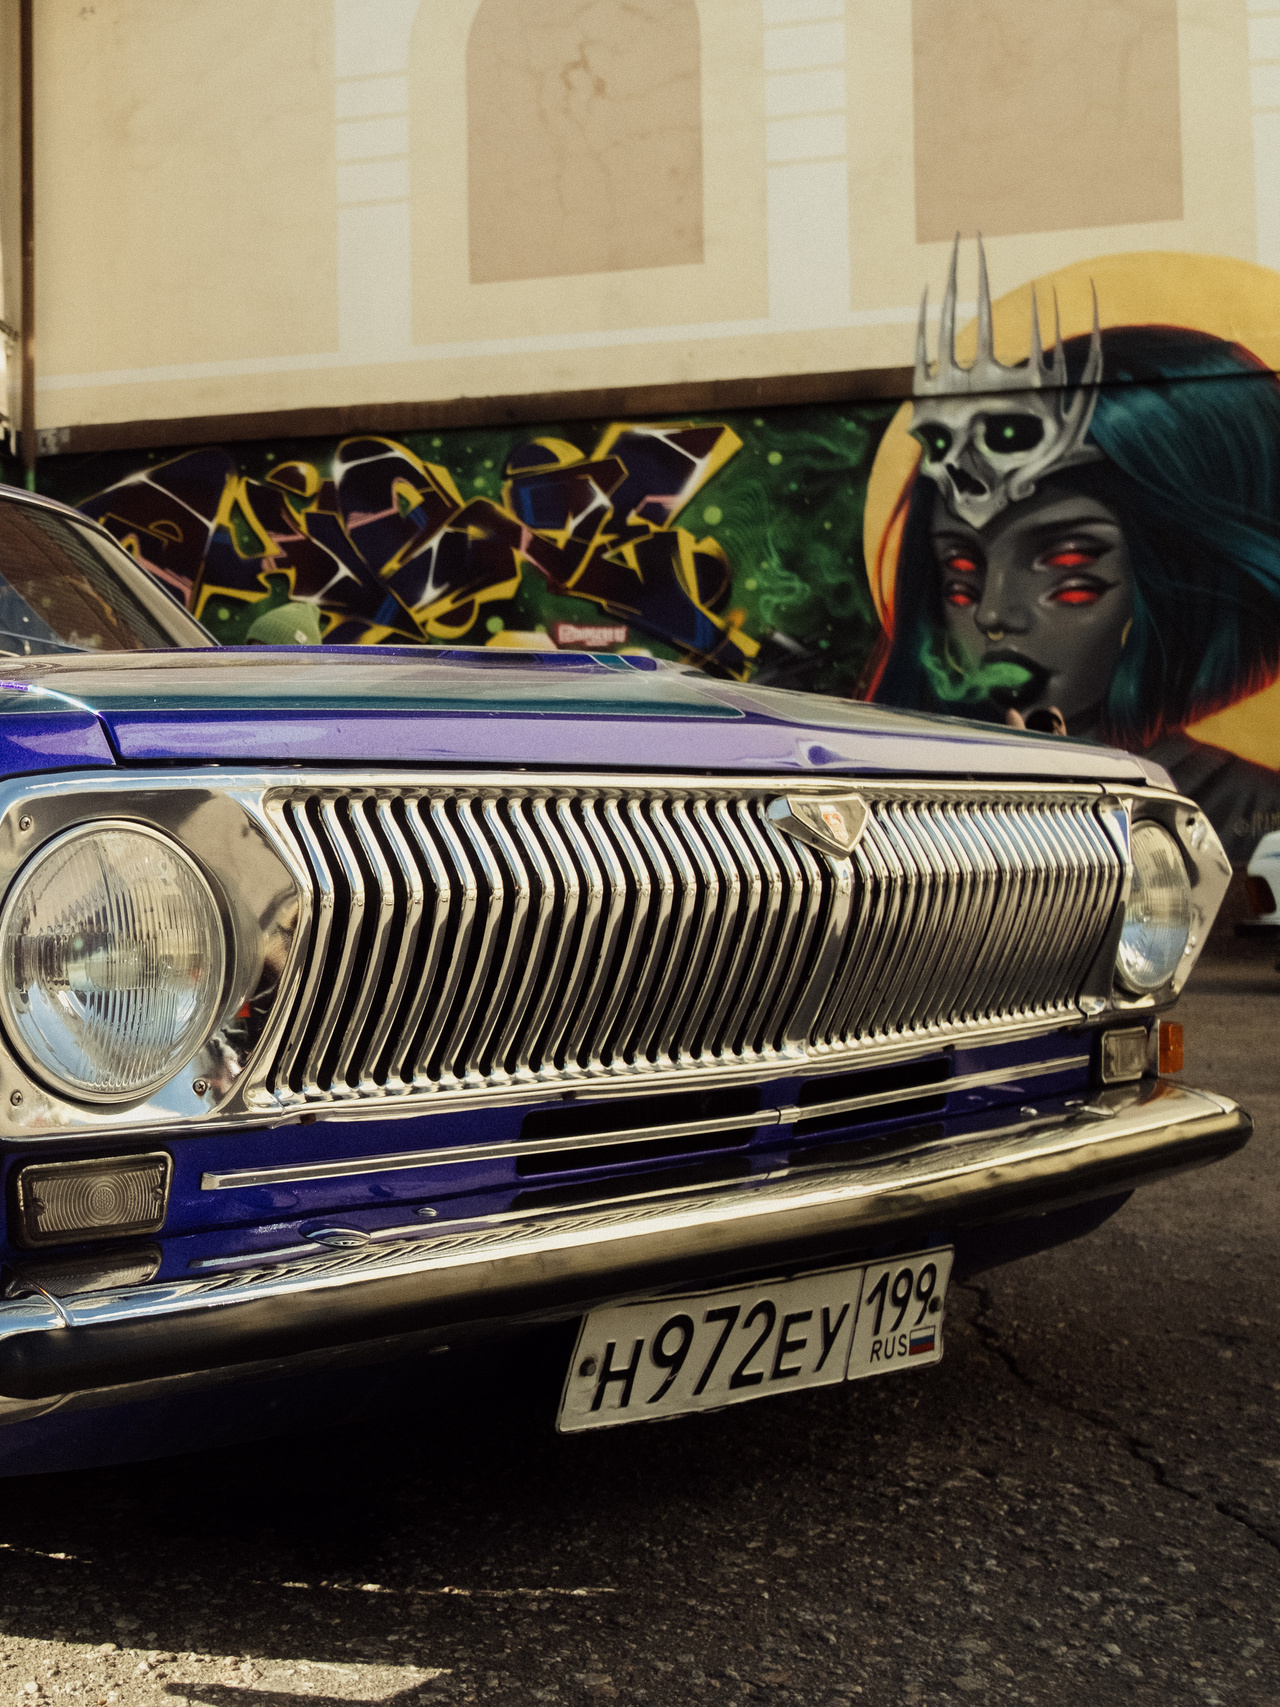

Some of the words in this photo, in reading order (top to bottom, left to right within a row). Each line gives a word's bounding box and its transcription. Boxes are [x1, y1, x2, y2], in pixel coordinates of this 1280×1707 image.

[590, 1299, 851, 1412] Н972ЕУ
[866, 1262, 938, 1337] 199
[869, 1333, 908, 1363] RUS
